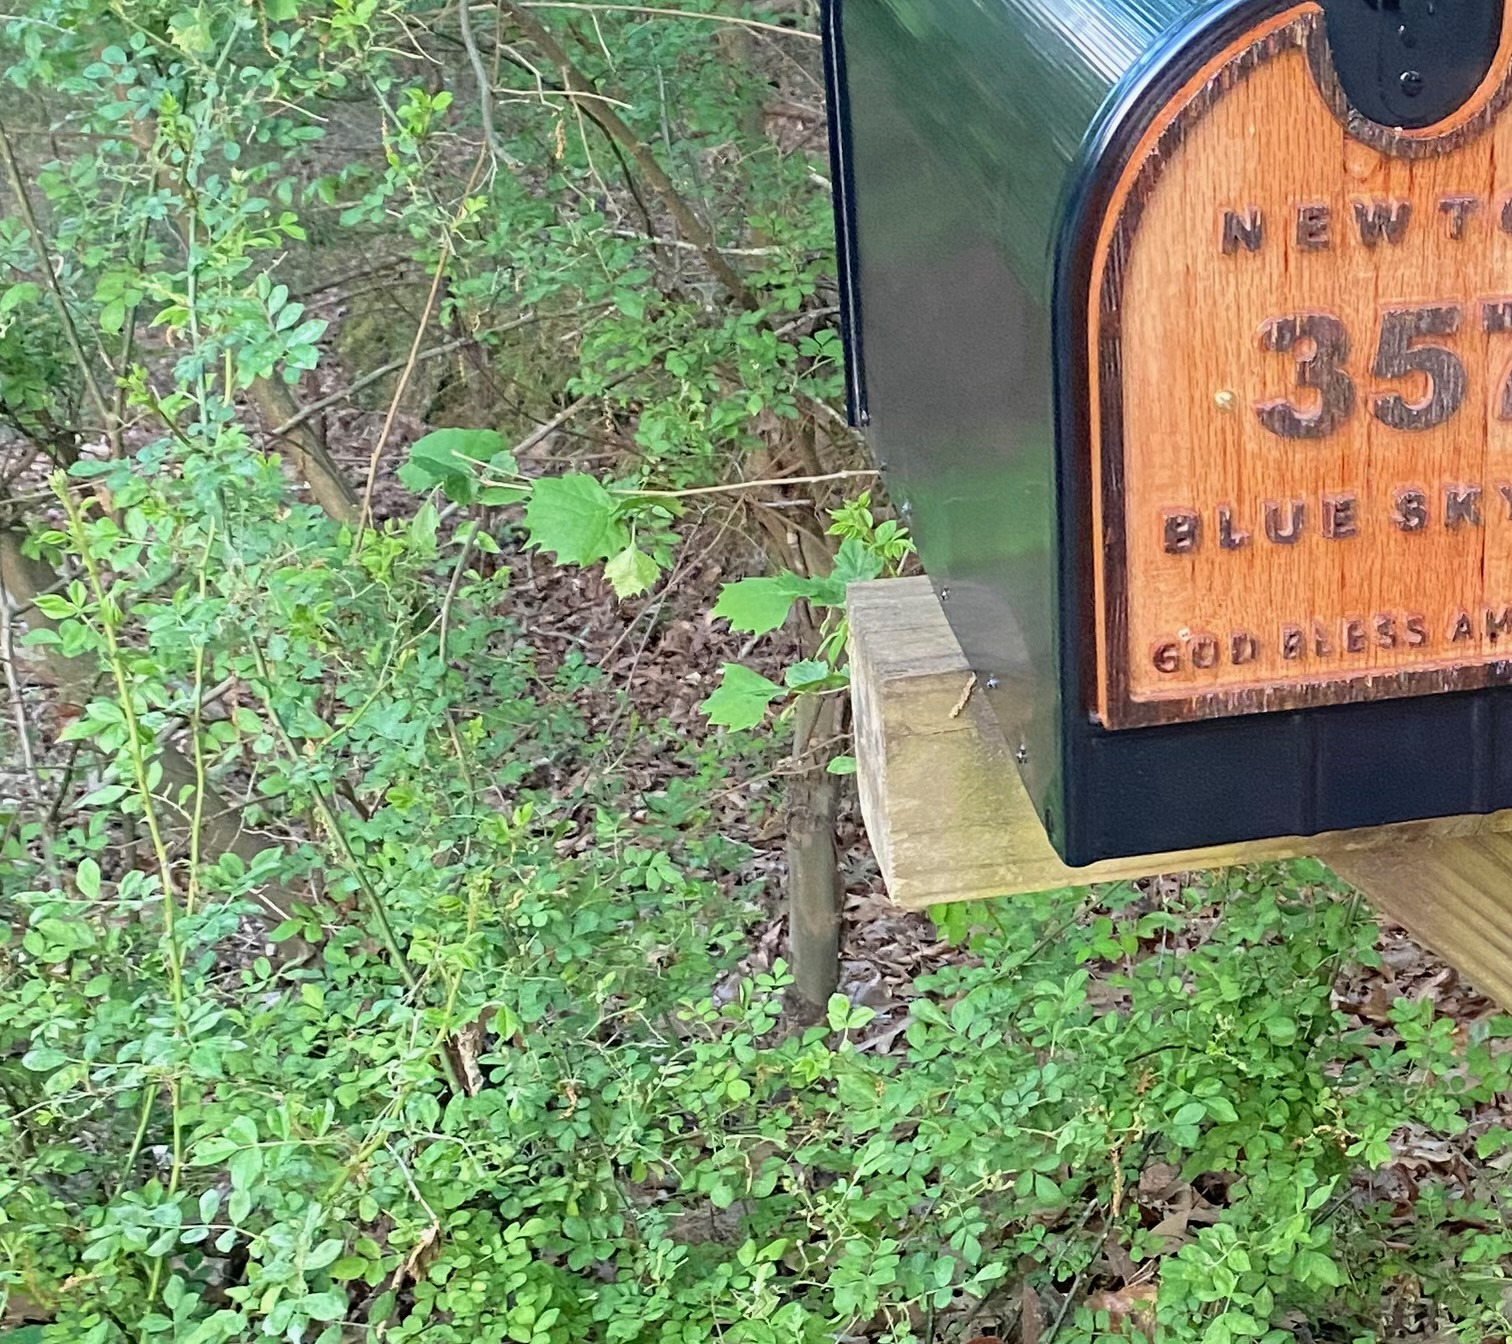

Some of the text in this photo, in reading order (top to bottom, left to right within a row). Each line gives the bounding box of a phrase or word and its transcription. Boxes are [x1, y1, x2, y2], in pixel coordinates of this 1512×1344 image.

[1160, 489, 1358, 555] BLUE
[1151, 631, 1258, 674] GOD
[1281, 613, 1427, 661] BLESS
